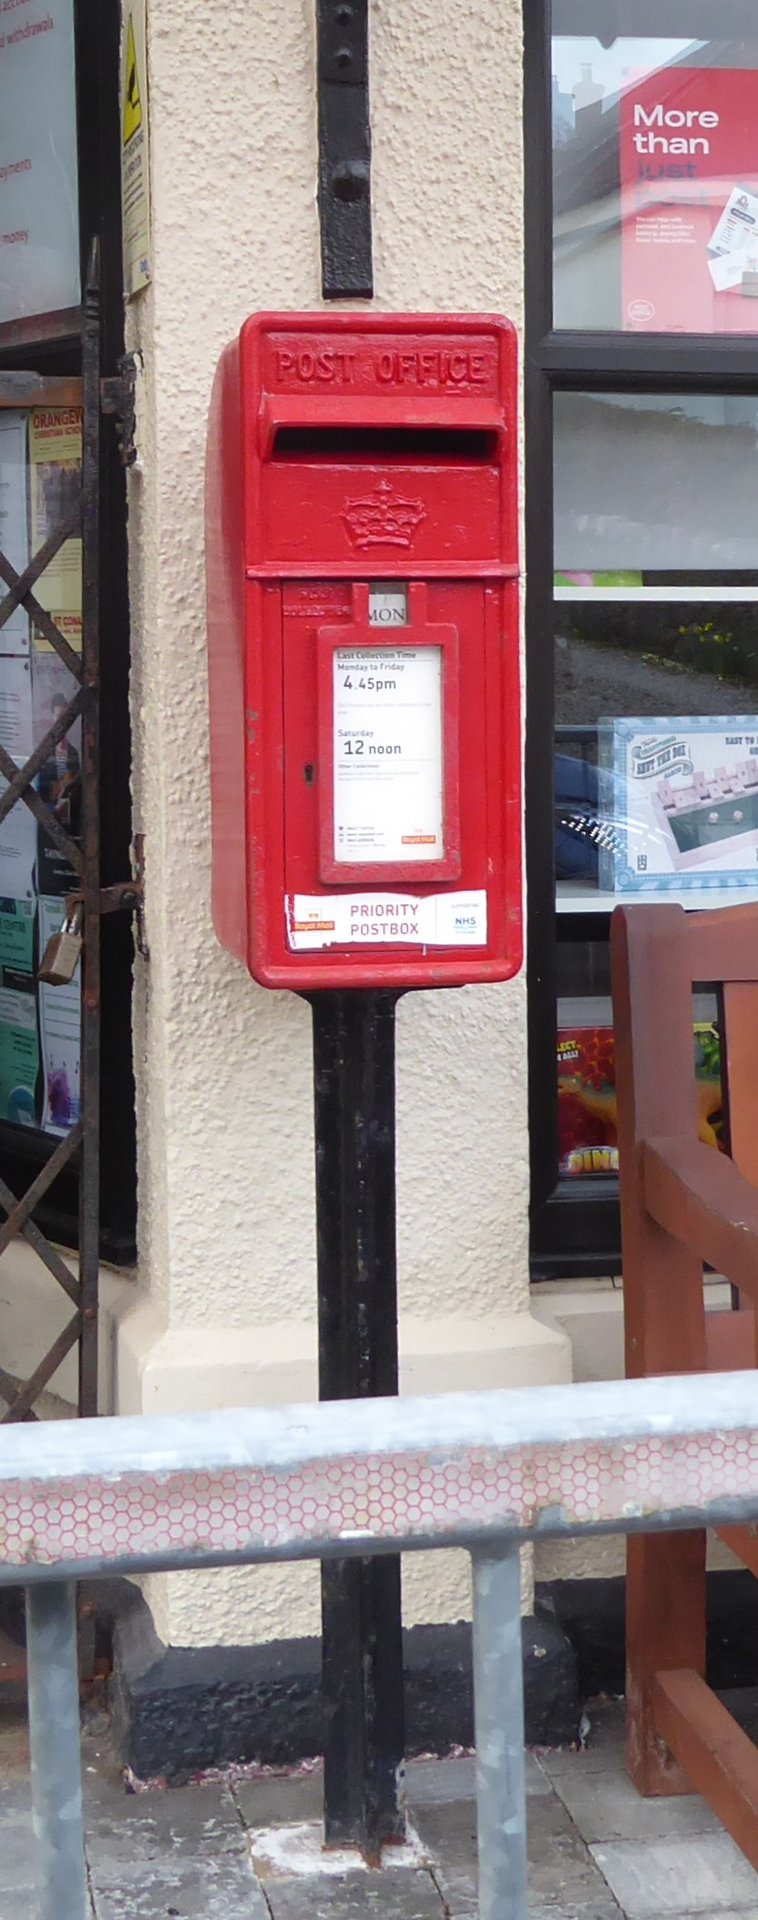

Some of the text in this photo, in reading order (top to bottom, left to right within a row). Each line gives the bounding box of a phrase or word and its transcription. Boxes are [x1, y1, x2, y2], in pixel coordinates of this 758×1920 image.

[7, 12, 53, 44] withdrawals
[633, 104, 719, 128] More
[633, 132, 709, 154] than
[638, 160, 696, 184] just
[276, 350, 487, 384] POST OFFICE
[337, 650, 417, 660] Last Collection Time
[337, 663, 405, 672] Monday to Friday
[343, 675, 397, 692] 4.45pm
[337, 729, 374, 738] Saturday
[343, 739, 402, 755] 12 noon
[725, 736, 754, 745] EASY TO
[350, 904, 419, 917] PRIORITY
[294, 921, 334, 931] Royal Mail
[455, 917, 476, 925] NHS
[350, 923, 419, 935] POSTBOX
